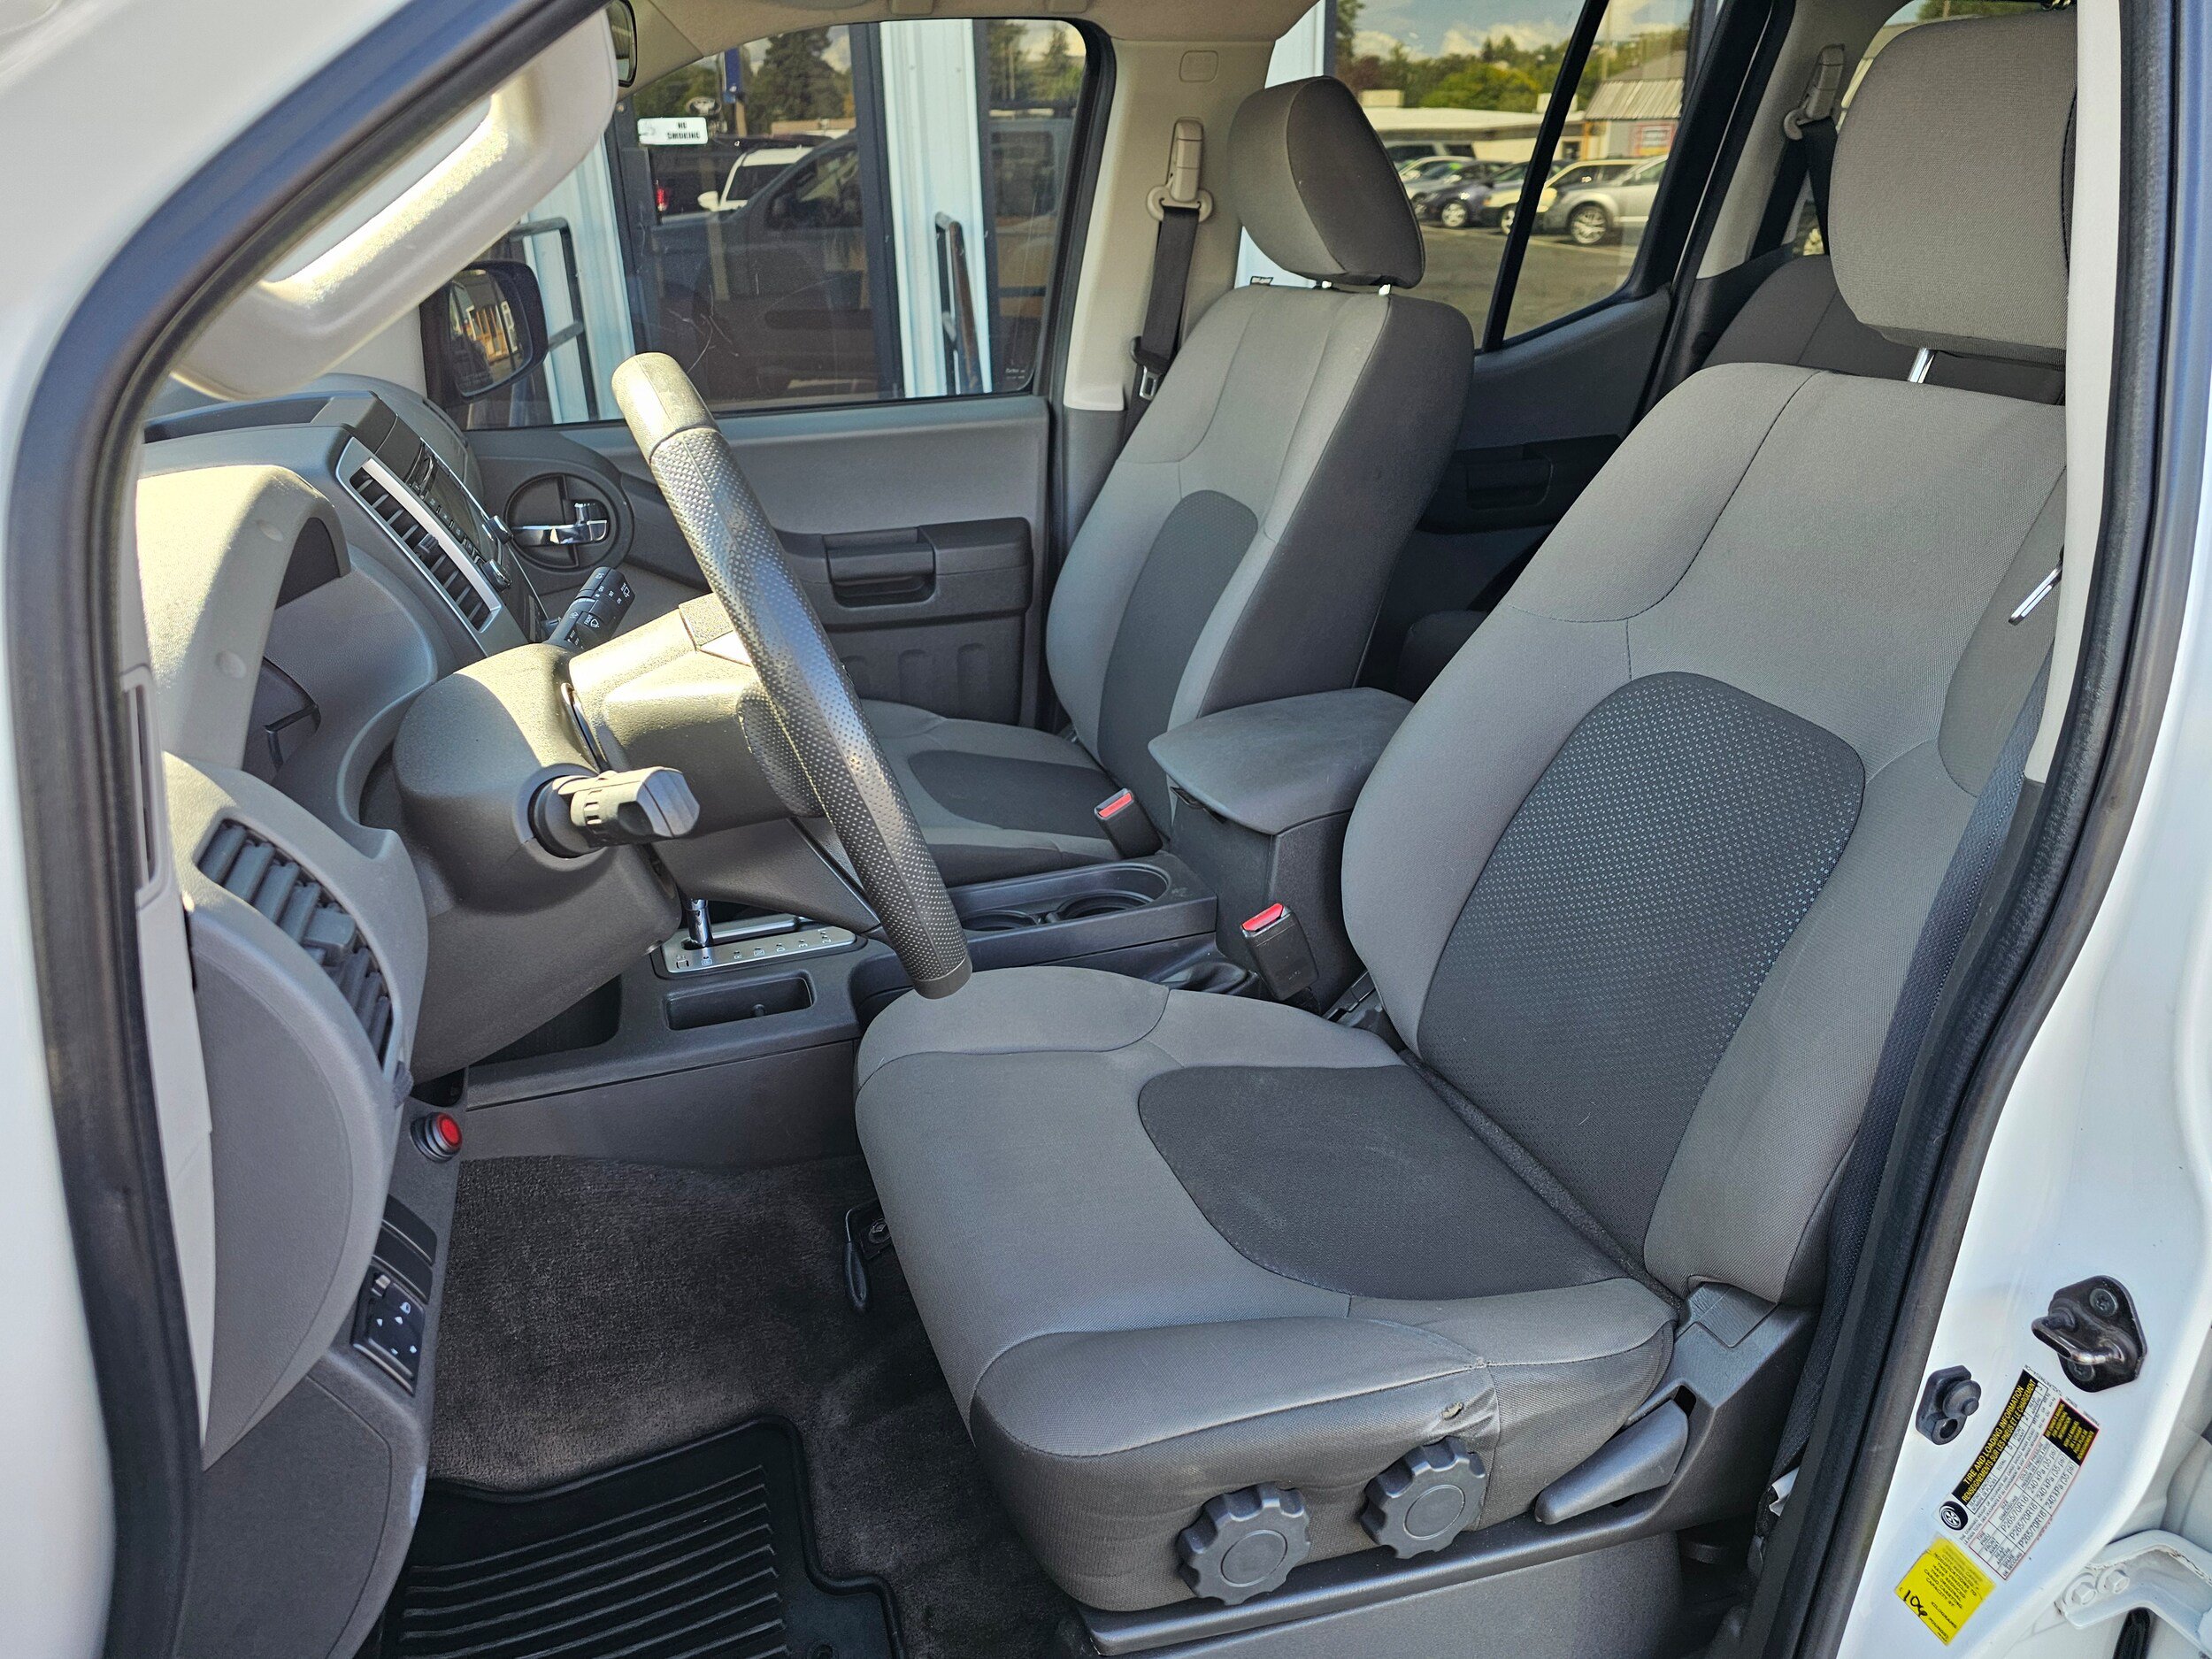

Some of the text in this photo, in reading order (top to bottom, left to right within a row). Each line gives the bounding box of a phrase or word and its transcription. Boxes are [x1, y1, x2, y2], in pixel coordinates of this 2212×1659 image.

[1961, 1378, 2036, 1502] RENSEIGNEMENTS SUR LES PNEUS ET LE CHARGEMENT
[1962, 1384, 2024, 1485] TIRE AND LOADING INFORMATION
[1996, 1457, 2006, 1471] TOTAL
[2018, 1468, 2028, 1481] COLD
[2026, 1445, 2059, 1494] 240 kPa (35 psi)
[2035, 1452, 2068, 1501] 240 kPa (35 psi)
[2000, 1499, 2008, 1509] SIZE
[2044, 1494, 2056, 1509] 240
[2051, 1482, 2063, 1497] kPa
[2059, 1471, 2070, 1486] (35
[2065, 1460, 2077, 1476] psi)
[2000, 1494, 2029, 1532] P265/70R16
[2008, 1501, 2038, 1540] P265/70R16
[2016, 1509, 2047, 1548] P265/70R16
